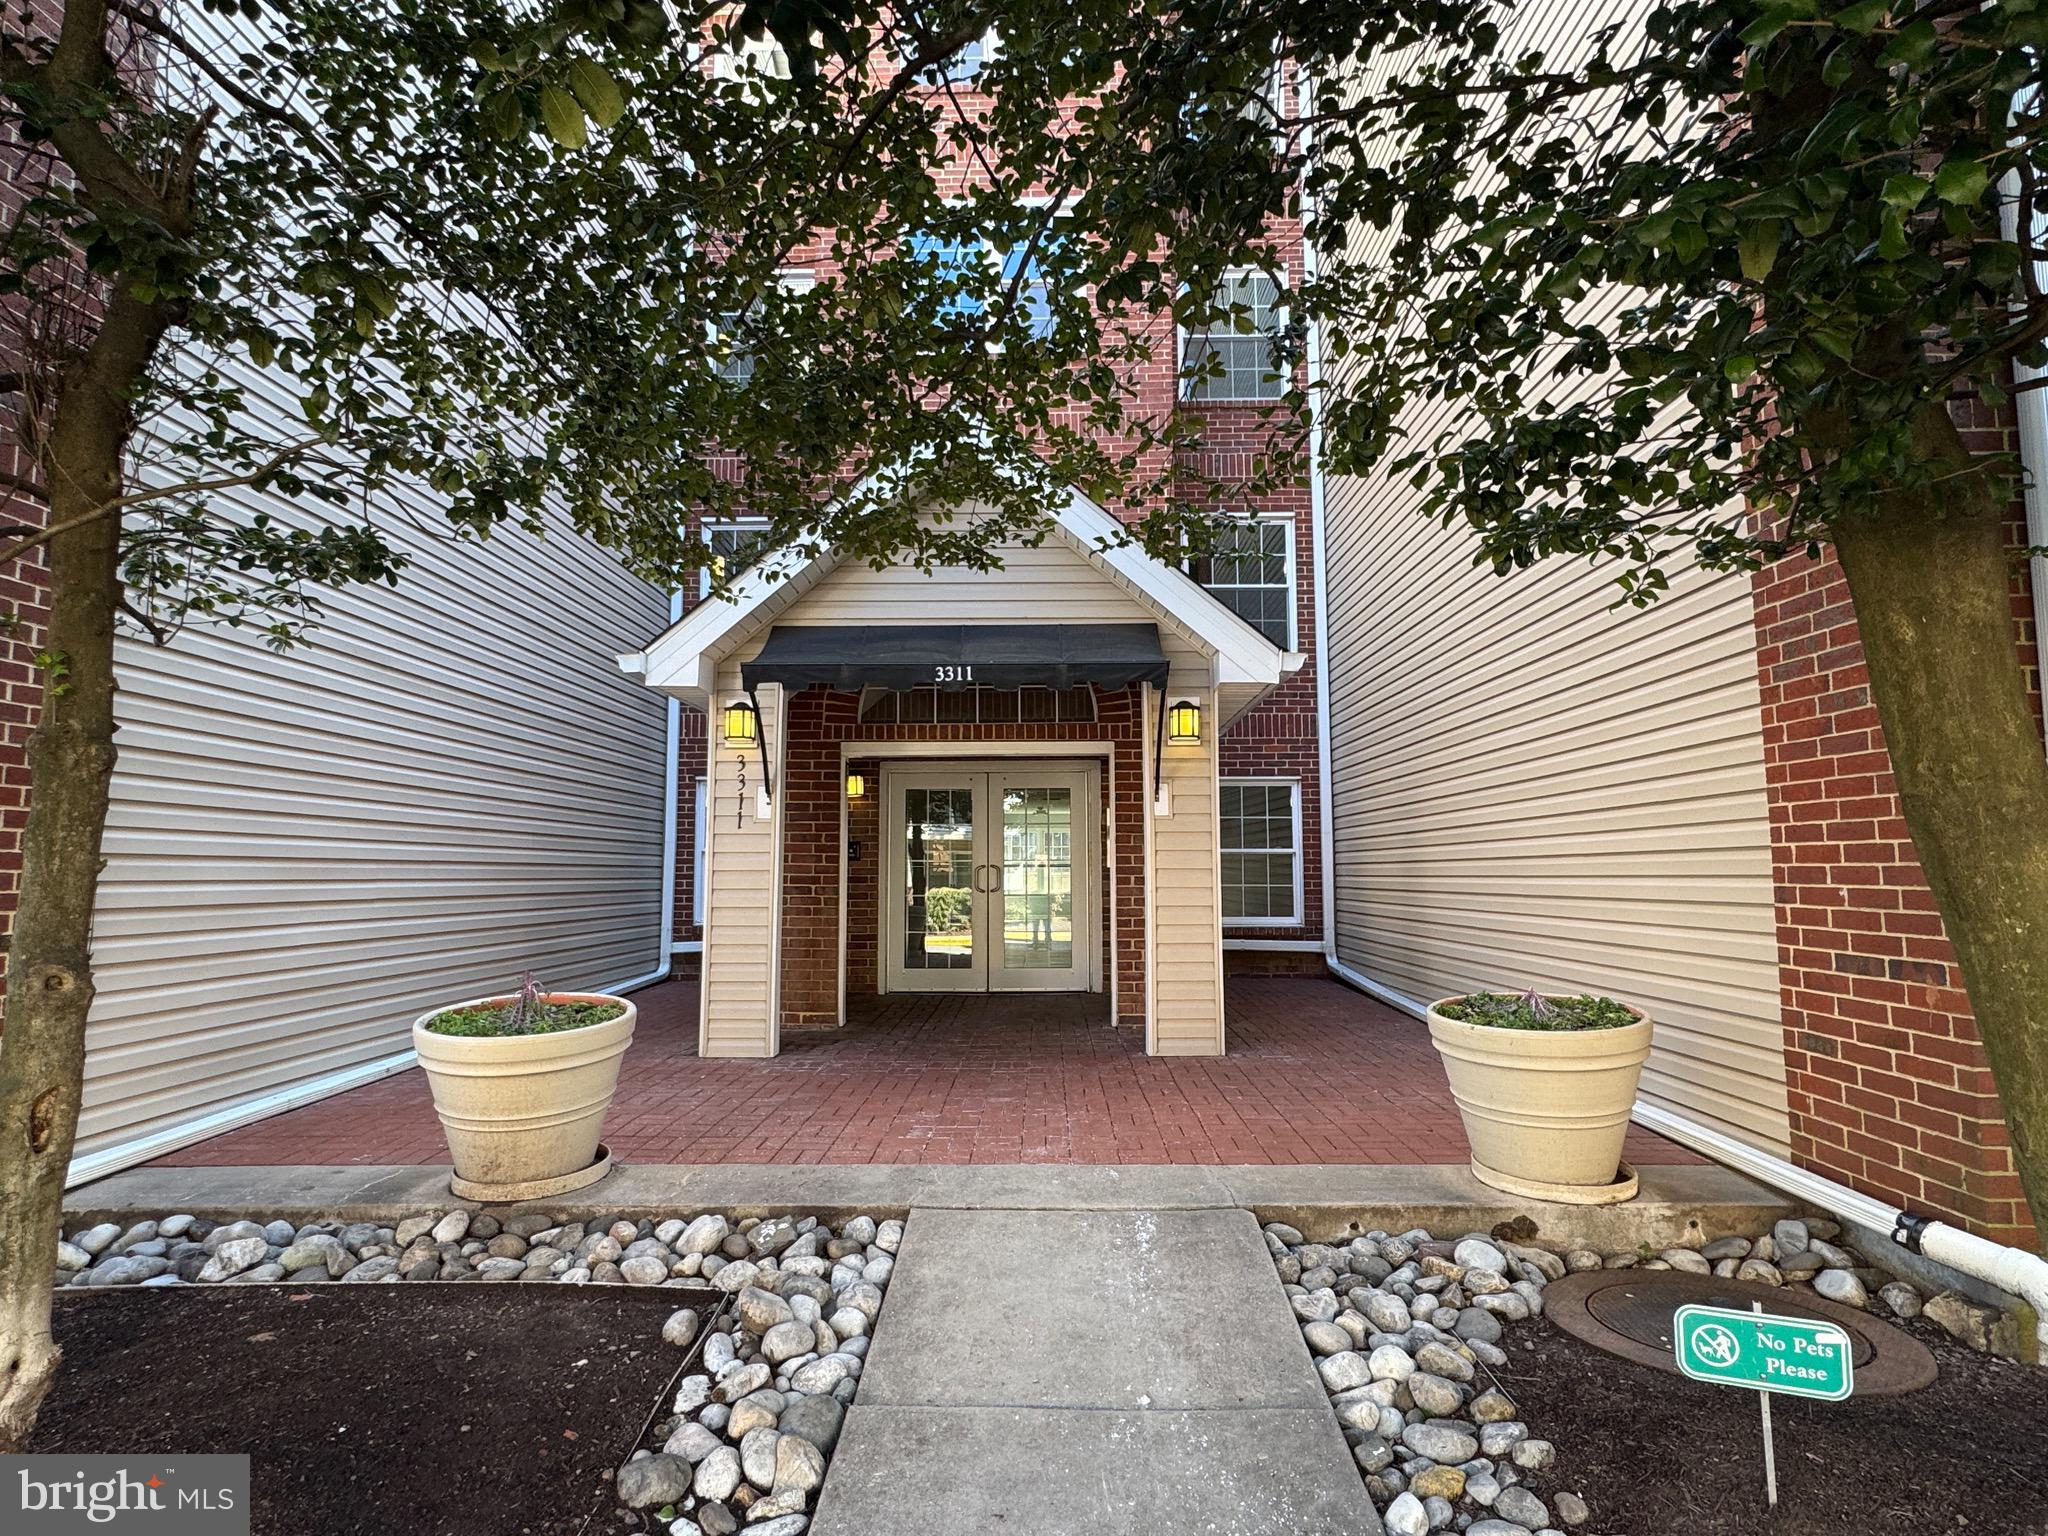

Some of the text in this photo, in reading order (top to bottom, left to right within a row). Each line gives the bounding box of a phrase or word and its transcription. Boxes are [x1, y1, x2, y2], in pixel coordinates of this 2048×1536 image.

[935, 665, 973, 682] 3311
[736, 754, 746, 830] 3311
[1756, 1331, 1834, 1358] No Pets
[1766, 1356, 1828, 1381] Please
